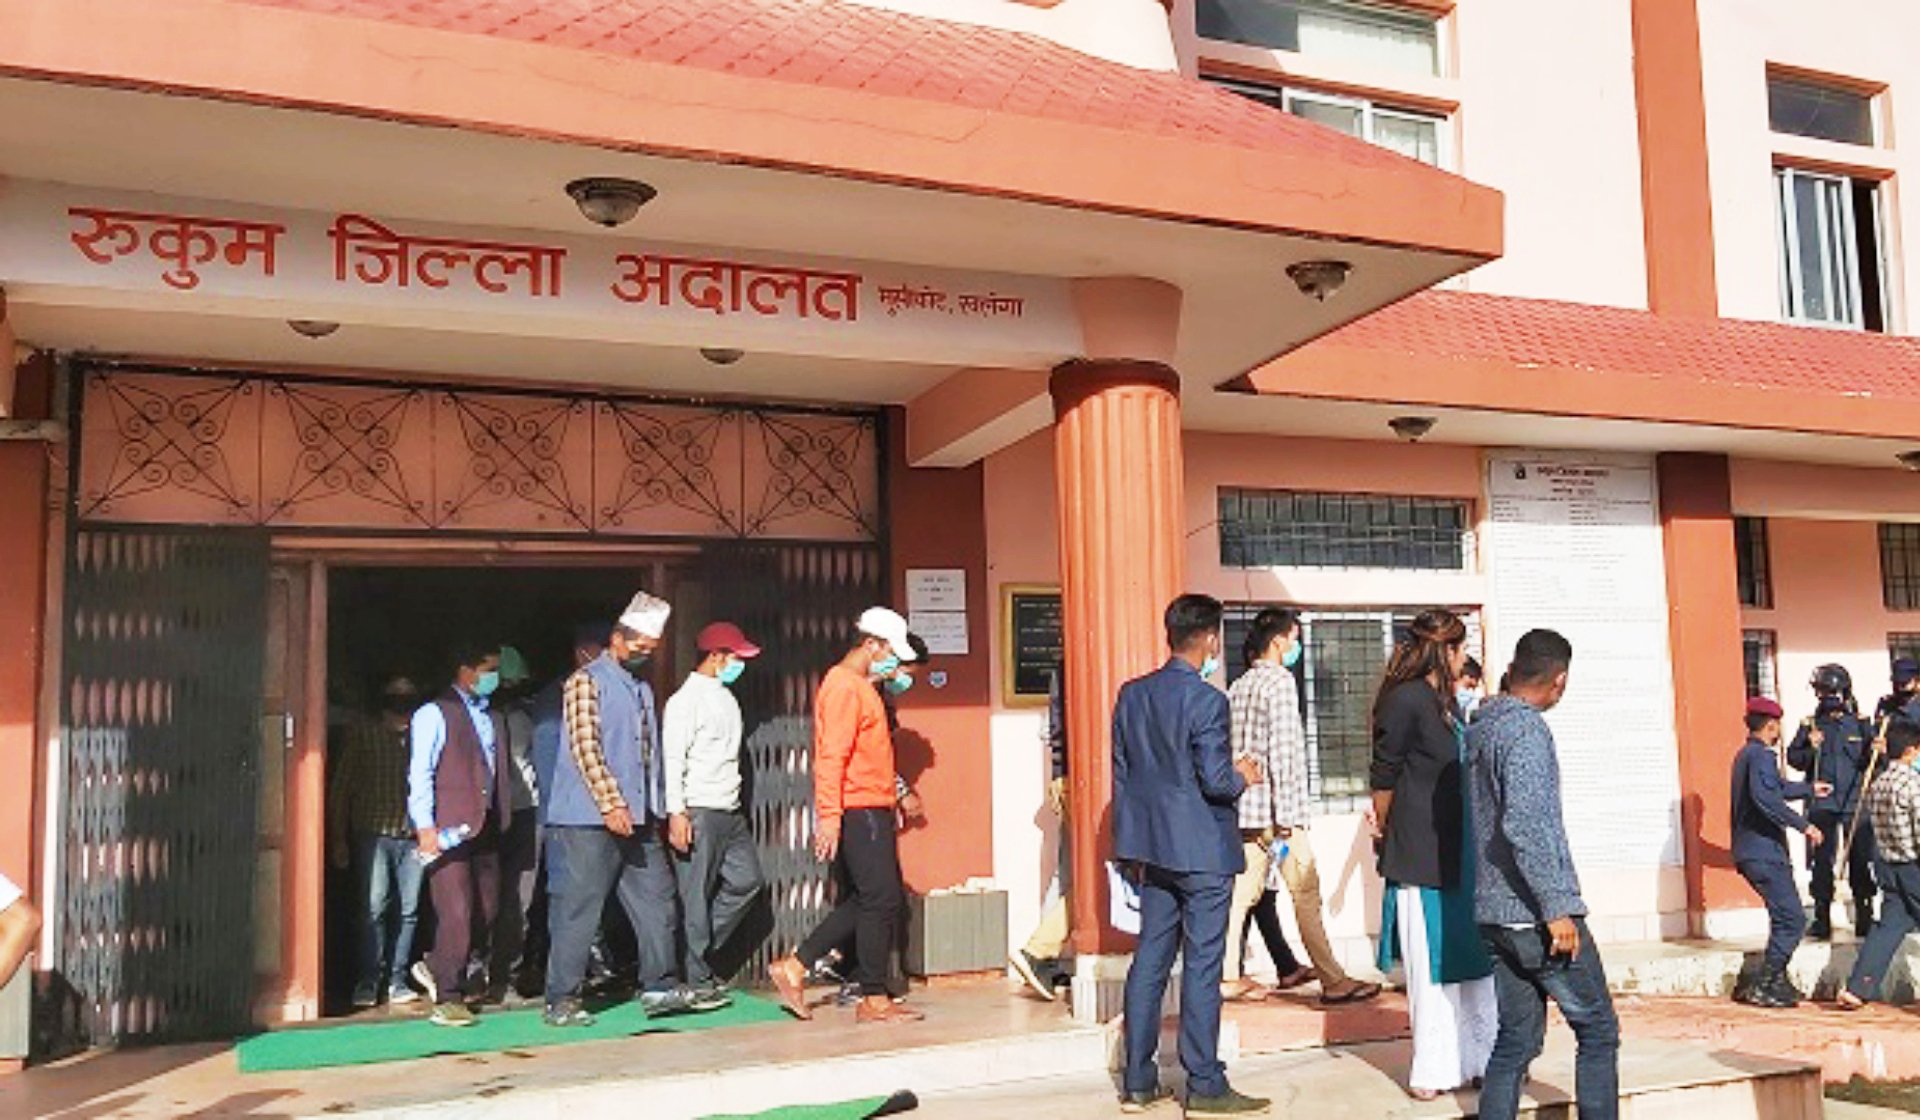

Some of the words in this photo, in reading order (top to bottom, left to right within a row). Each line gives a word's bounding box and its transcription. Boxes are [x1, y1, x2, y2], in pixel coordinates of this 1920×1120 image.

[68, 206, 286, 290] रुकुम
[327, 213, 567, 298] जिल्ला
[610, 253, 862, 321] अदालत
